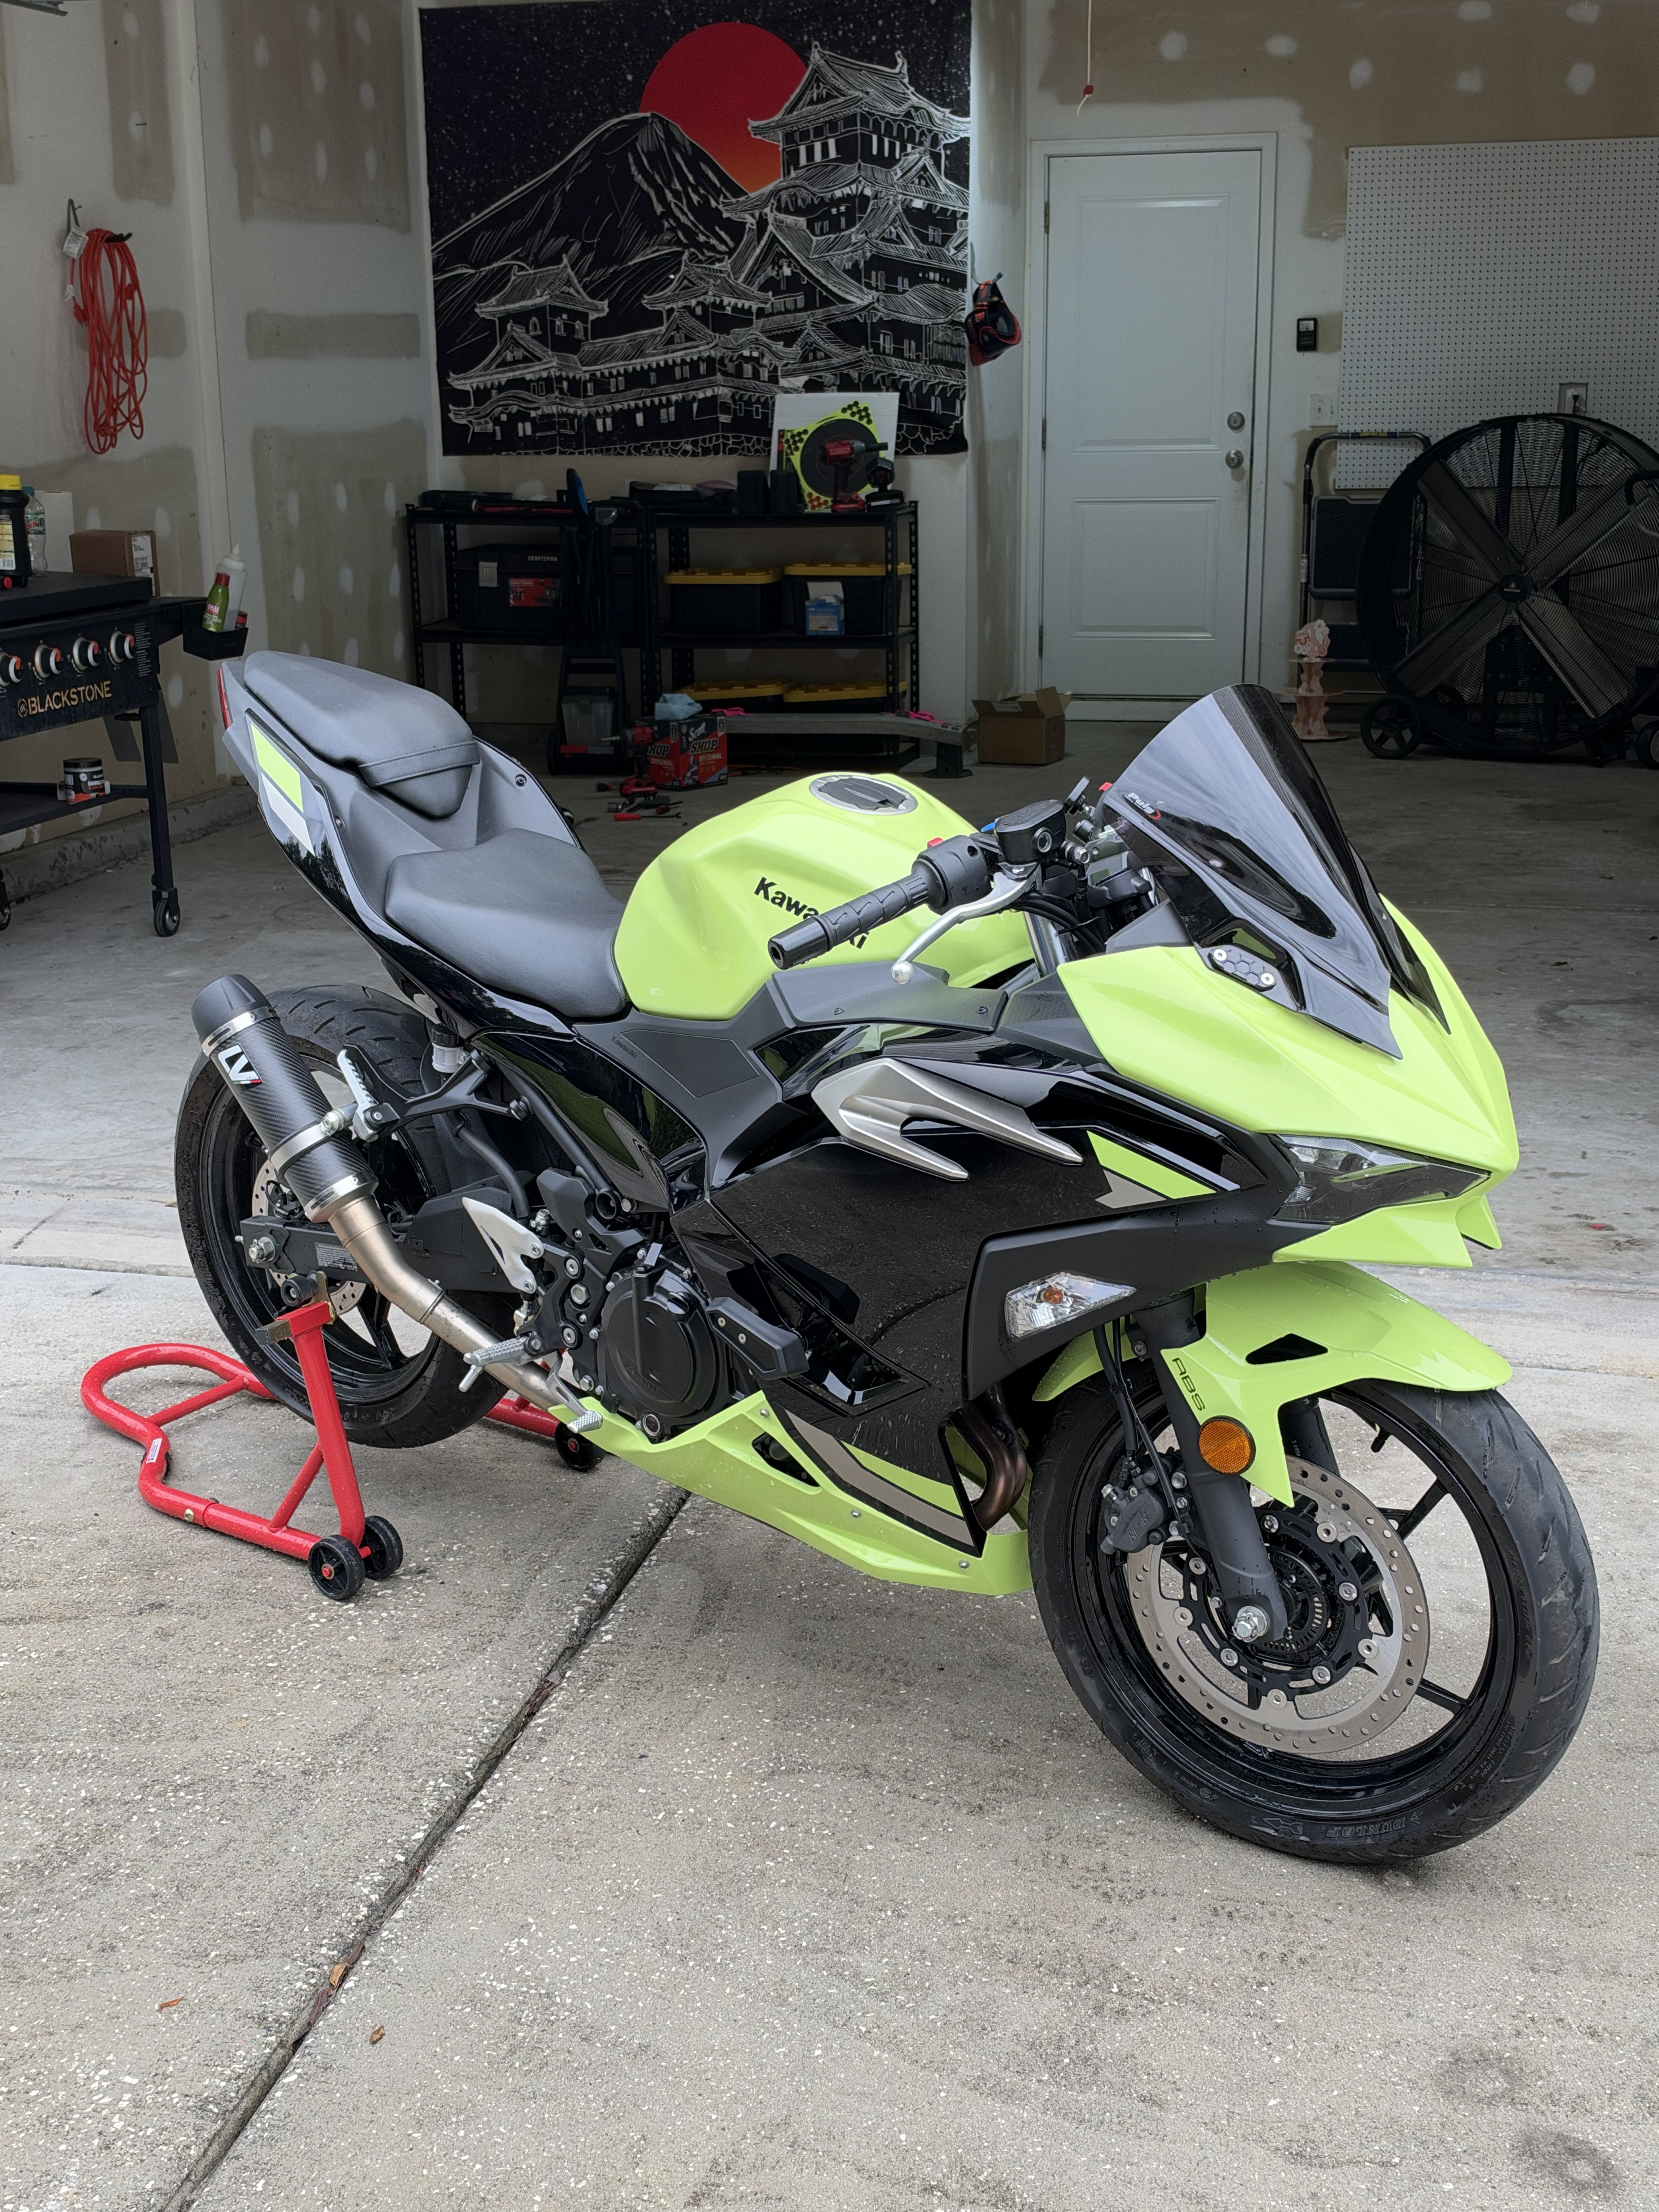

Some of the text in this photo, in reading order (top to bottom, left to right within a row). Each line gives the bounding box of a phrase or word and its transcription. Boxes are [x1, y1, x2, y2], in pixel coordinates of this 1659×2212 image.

[208, 604, 220, 615] PAM
[27, 680, 112, 715] BLACKSTONE
[647, 743, 670, 757] HOP
[689, 738, 718, 755] SHOP
[1127, 792, 1155, 814] Puig
[611, 1035, 637, 1059] Kawasaki
[1172, 1357, 1205, 1411] ABS
[1326, 1817, 1406, 1838] DUNLOP
